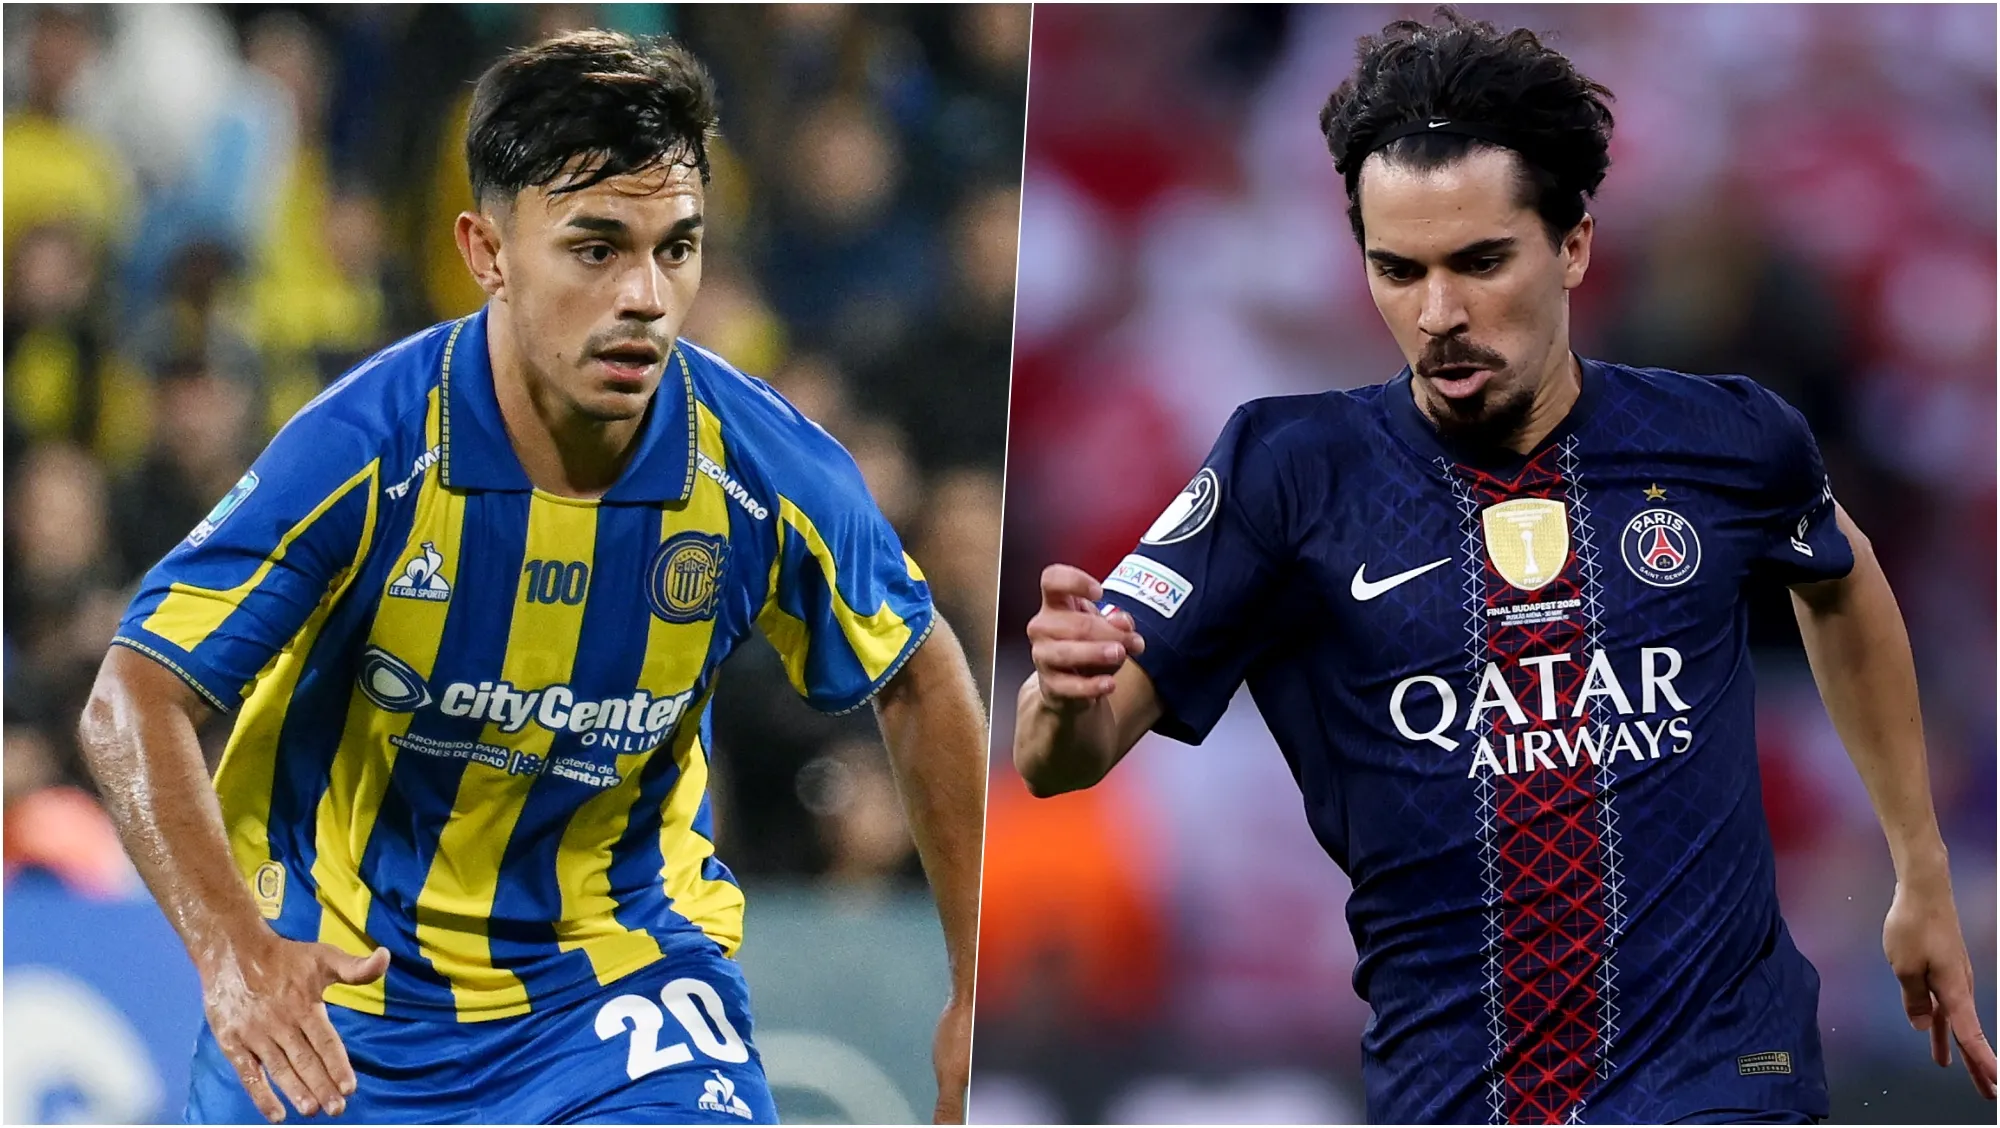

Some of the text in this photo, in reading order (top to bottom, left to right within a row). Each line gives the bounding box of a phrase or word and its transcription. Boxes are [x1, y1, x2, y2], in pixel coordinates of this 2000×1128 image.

[1631, 512, 1684, 534] PARIS
[524, 559, 589, 606] 100
[1639, 566, 1660, 580] SAINT
[389, 585, 449, 600] LE COQ SPORTIF
[1487, 598, 1581, 617] FINAL BUDAPEST 2026
[1389, 647, 1692, 752] QATAR
[391, 737, 506, 768] MENORES DE EDAD
[407, 733, 508, 757] PROHIBIDO PARA
[1467, 717, 1693, 778] AIRWAYS
[552, 765, 621, 788] Santa Fe
[555, 756, 614, 775] Lotería de
[594, 977, 749, 1081] 20
